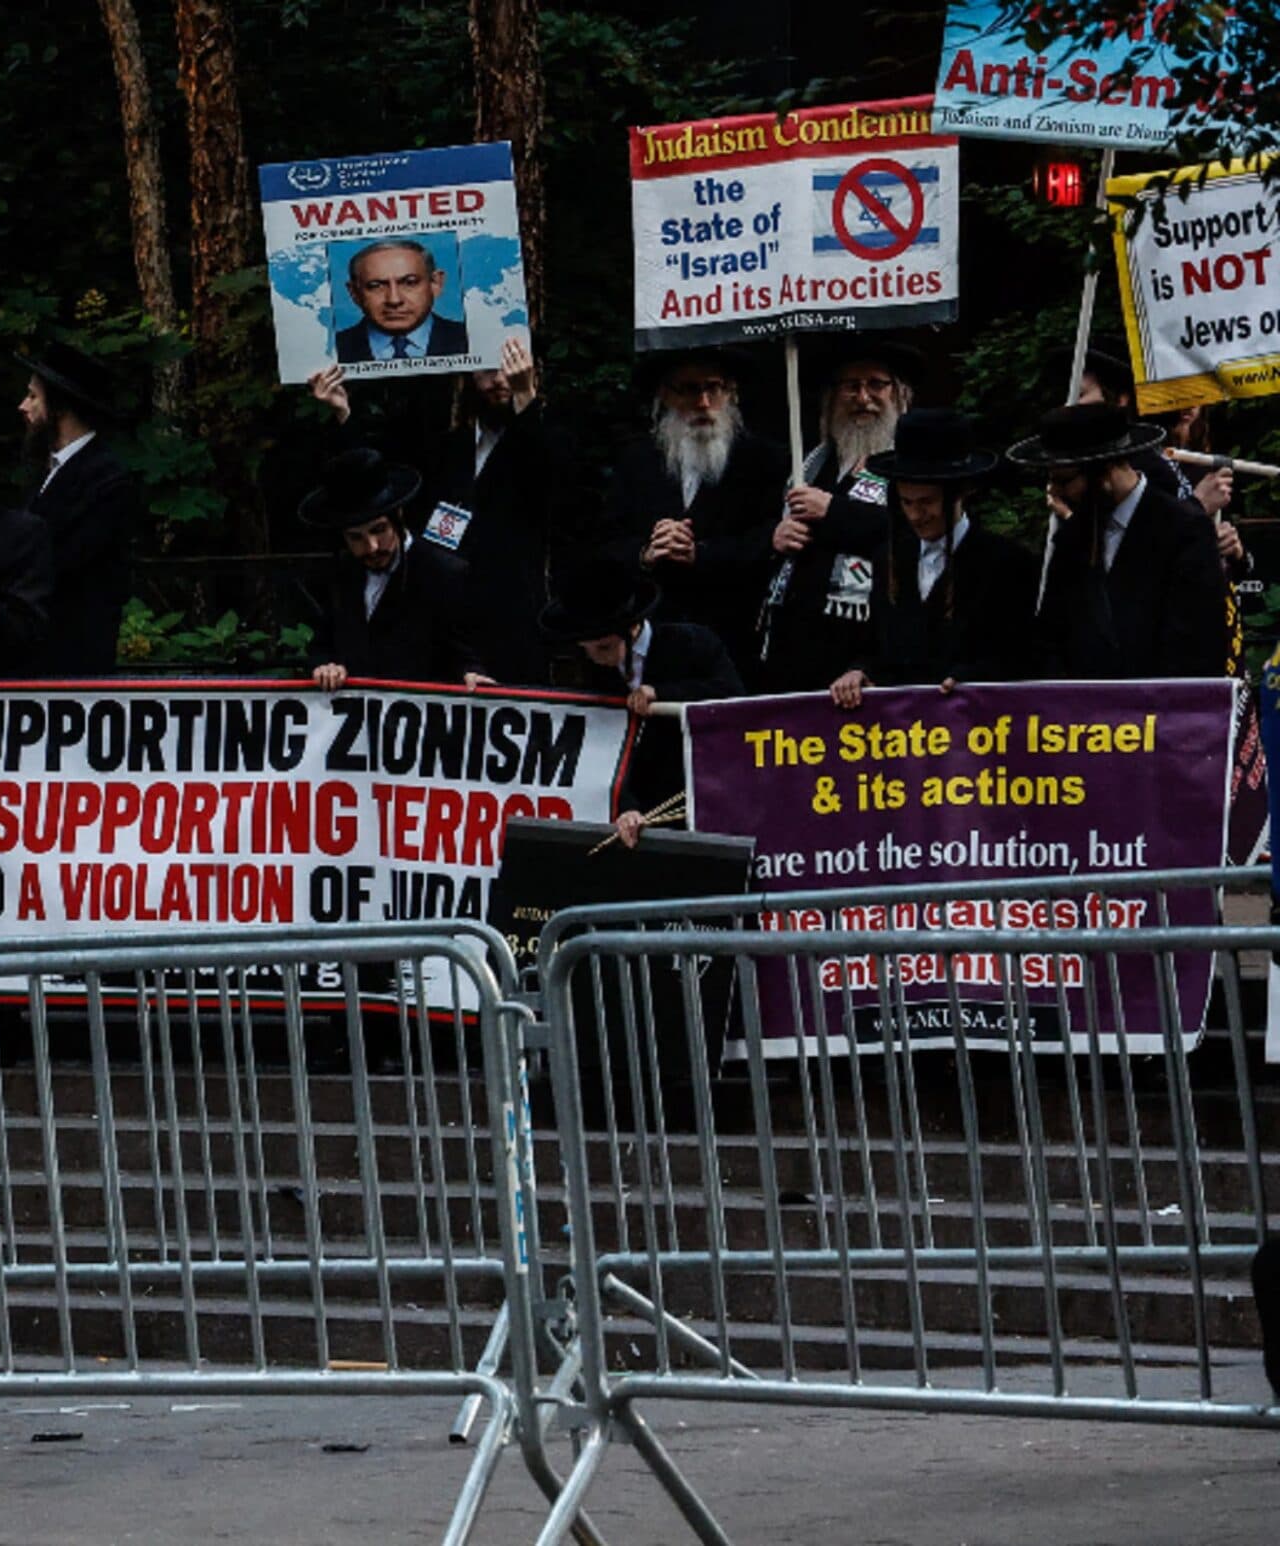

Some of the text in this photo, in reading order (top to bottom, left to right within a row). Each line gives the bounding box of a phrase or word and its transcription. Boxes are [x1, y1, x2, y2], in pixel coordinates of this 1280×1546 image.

[943, 49, 1255, 113] Anti-Sem
[643, 106, 930, 165] Judaism Condemn
[1003, 115, 1031, 130] and
[1036, 116, 1095, 135] Zionism
[1099, 124, 1122, 137] are
[291, 189, 486, 228] WANTED
[694, 178, 744, 205] the
[660, 203, 781, 246] State of
[1154, 201, 1268, 251] Support
[660, 265, 942, 320] And its Atrocities
[1151, 248, 1272, 301] is NOT
[1181, 313, 1251, 350] Jews
[339, 360, 398, 376] enjamin
[326, 696, 586, 788] ZIONISM
[746, 714, 1157, 767] The State of Israel
[812, 767, 1086, 814] & its actions
[372, 782, 573, 867] TERR
[756, 829, 1148, 878] are not the solution, but
[17, 863, 46, 921] A
[60, 863, 294, 923] VIOLATION
[310, 866, 375, 923] OF
[383, 869, 482, 922] JUDA
[1086, 892, 1145, 929] for
